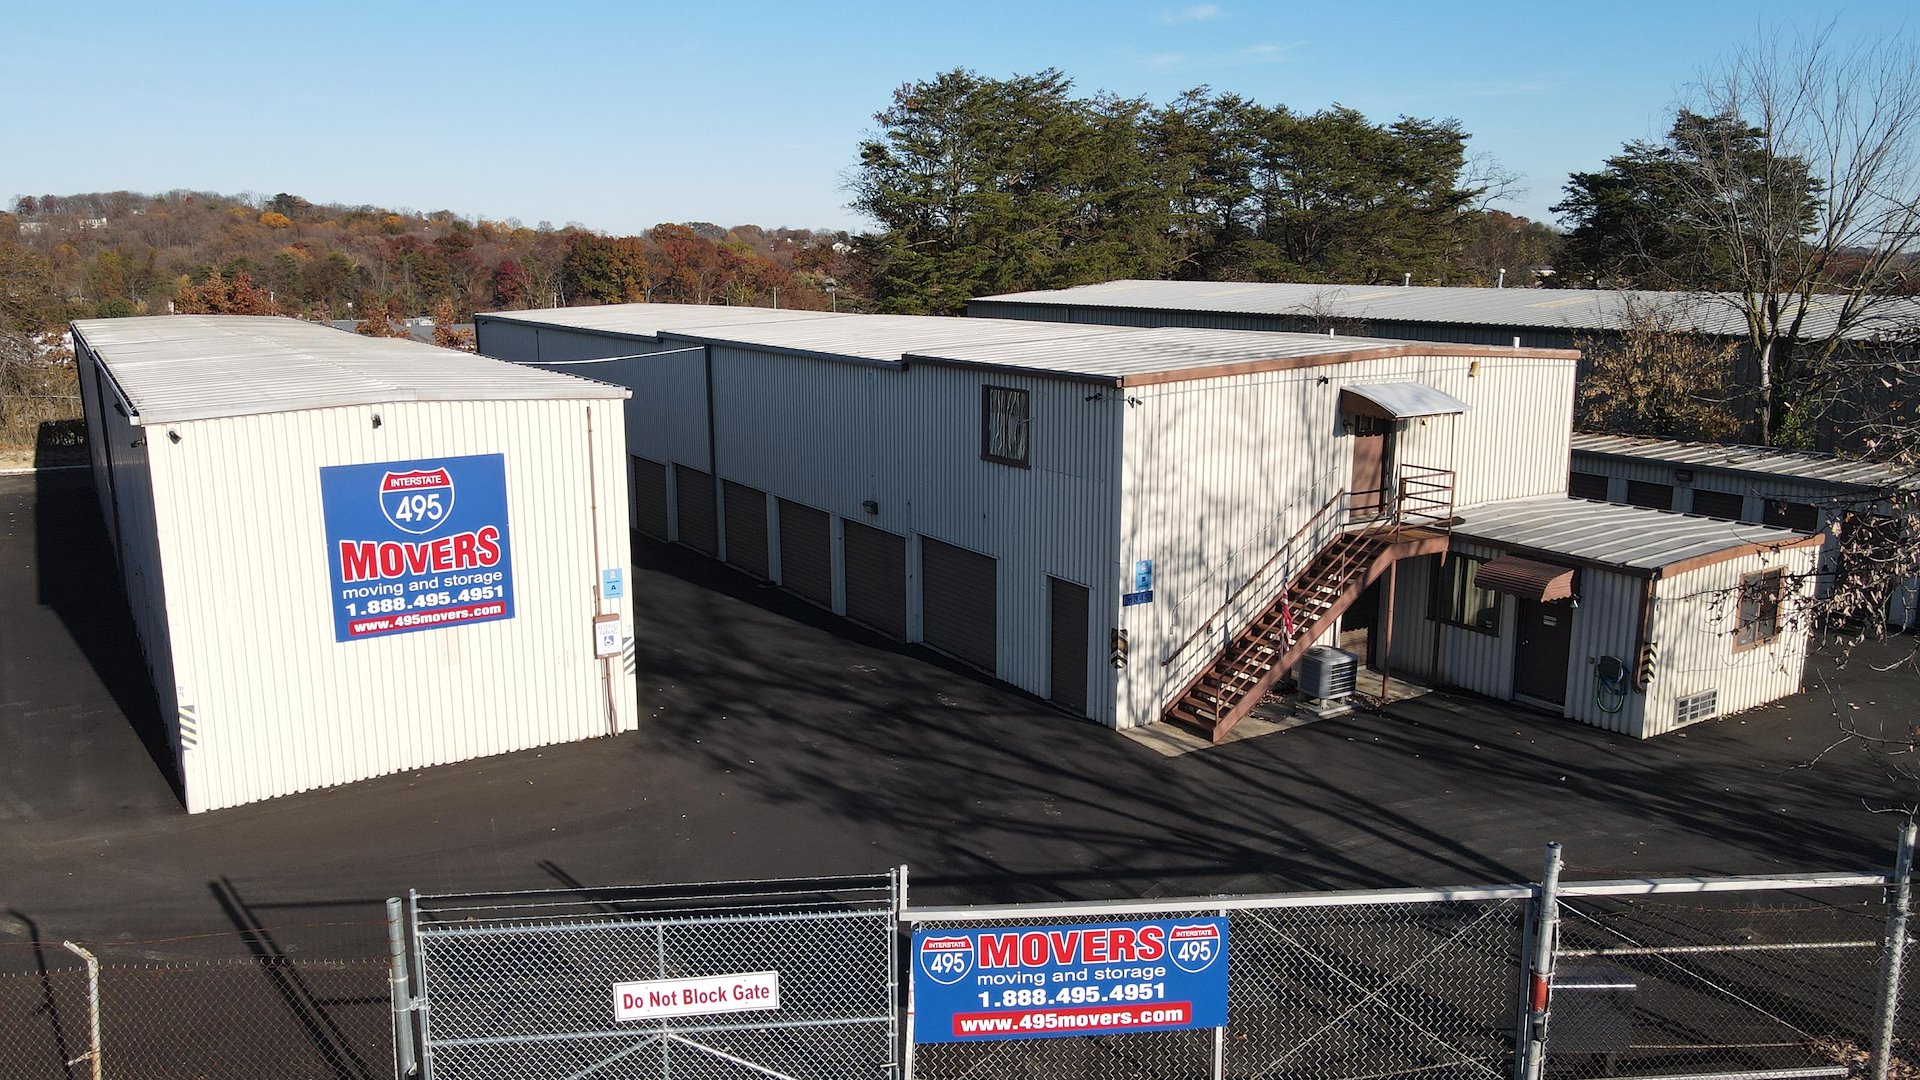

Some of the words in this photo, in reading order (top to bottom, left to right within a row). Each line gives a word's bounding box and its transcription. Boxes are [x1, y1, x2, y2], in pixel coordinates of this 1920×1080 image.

[391, 474, 442, 487] INTERSTATE
[395, 494, 442, 522] 495
[339, 525, 501, 583] MOVERS
[343, 582, 404, 599] moving
[409, 577, 439, 591] and
[444, 571, 503, 587] storage
[345, 585, 503, 617] 1.888.495.4951
[354, 604, 502, 633] www.495movers.com
[928, 941, 966, 949] INTERSTATE
[1175, 929, 1213, 937] INTERSTATE
[978, 925, 1166, 969] MOVERS
[1177, 941, 1211, 962] 495
[931, 953, 965, 973] 495
[977, 971, 1046, 986] moving
[1052, 968, 1088, 983] and
[1094, 966, 1167, 980] storage
[623, 993, 644, 1010] Do
[649, 990, 678, 1007] Not
[683, 986, 728, 1005] Block
[733, 984, 770, 1001] Gate
[978, 982, 1165, 1008] 1.888.495.4951
[960, 1008, 1183, 1032] www.495movers.com
